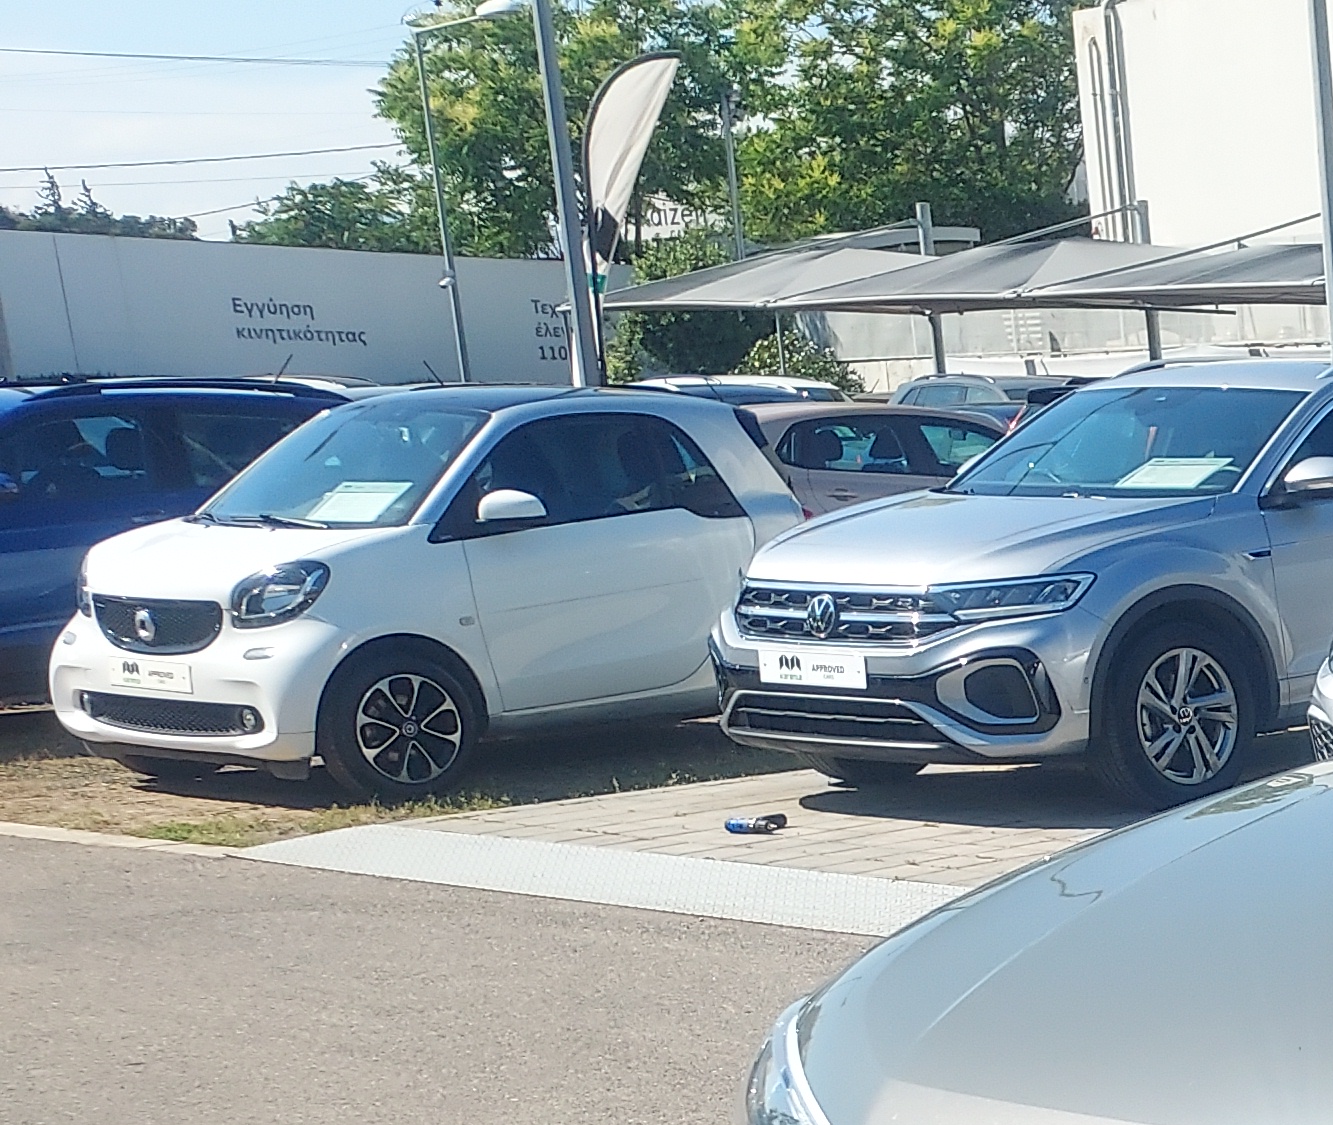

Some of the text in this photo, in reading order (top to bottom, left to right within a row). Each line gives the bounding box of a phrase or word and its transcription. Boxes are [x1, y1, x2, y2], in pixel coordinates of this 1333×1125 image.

[231, 297, 315, 320] Εγγύηση
[236, 324, 368, 346] κινητικότητας
[539, 345, 568, 361] 110
